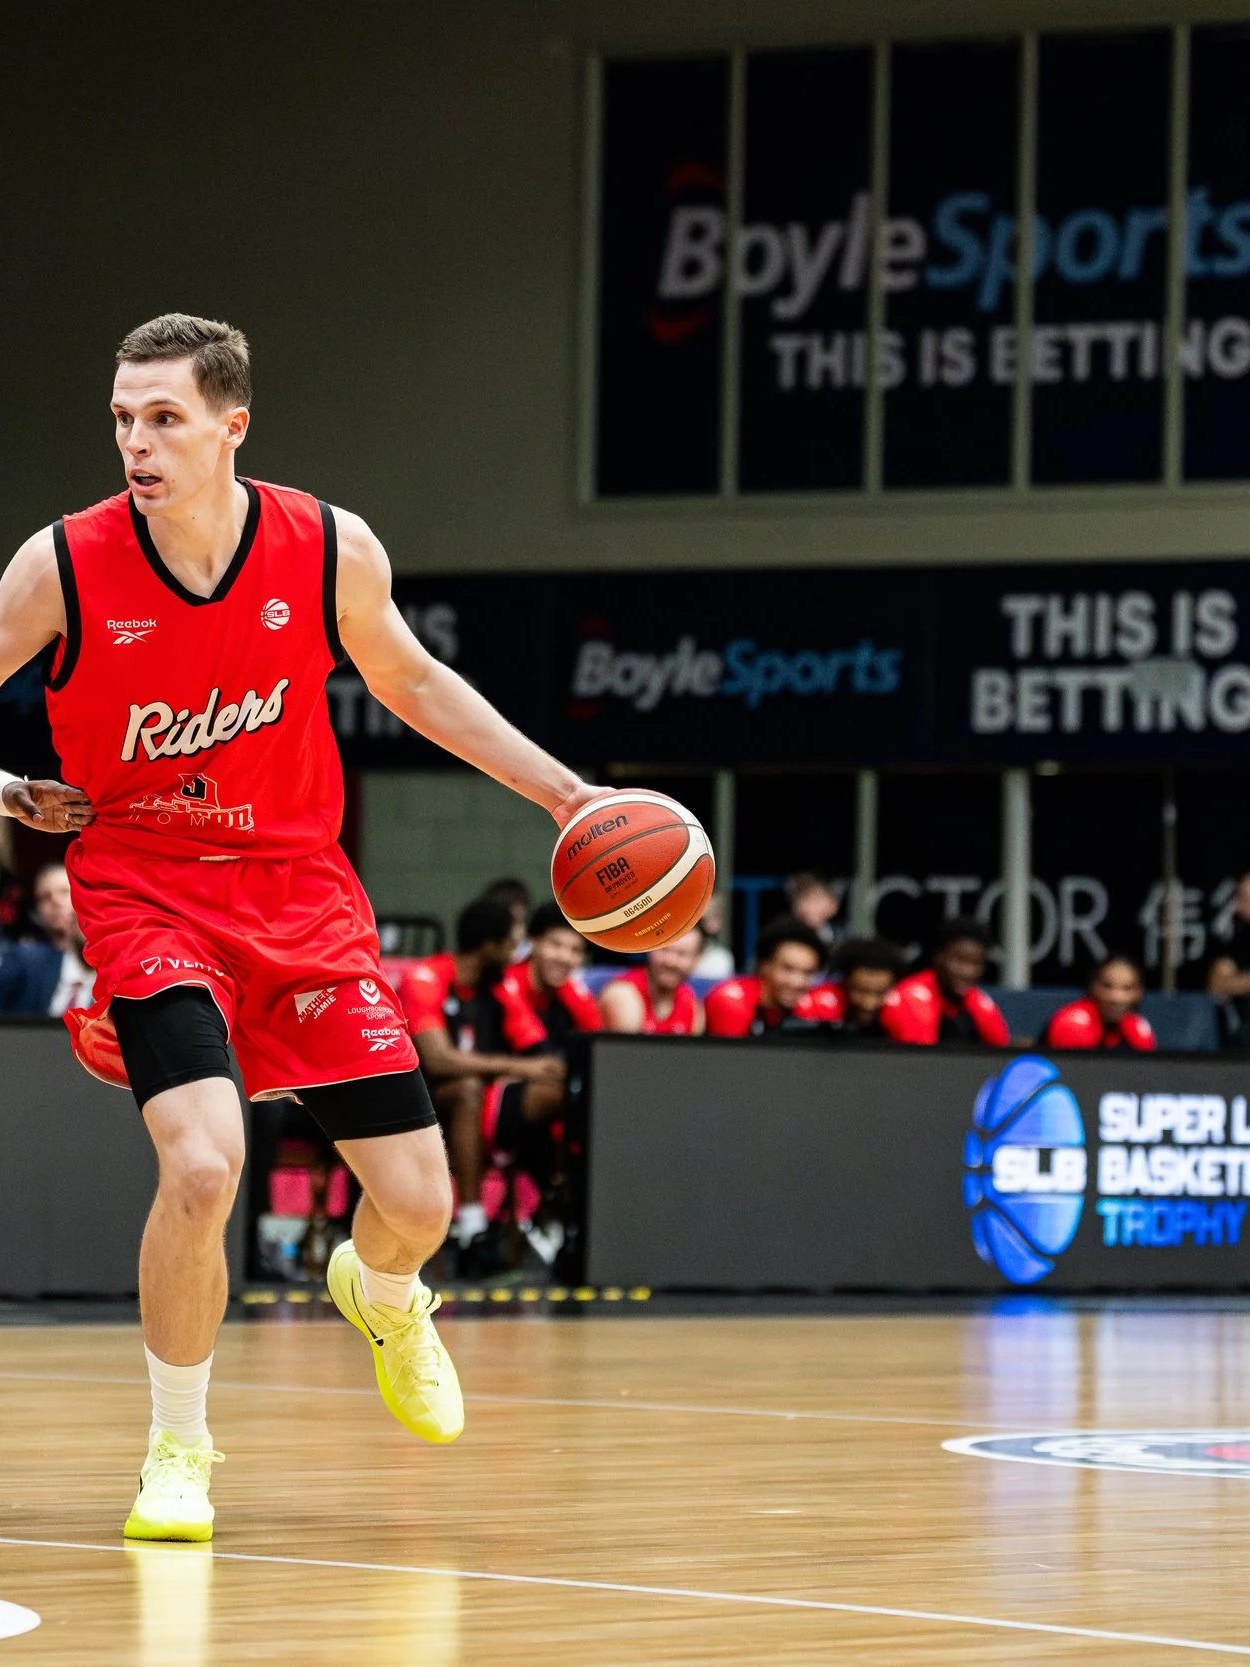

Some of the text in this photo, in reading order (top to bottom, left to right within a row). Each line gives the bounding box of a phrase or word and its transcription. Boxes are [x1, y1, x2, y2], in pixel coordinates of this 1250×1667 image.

[769, 330, 907, 390] THIS
[918, 330, 975, 385] IS
[107, 618, 157, 630] Reebok
[267, 609, 290, 618] SLB
[1000, 590, 1238, 659] THIS IS
[571, 635, 903, 712] BoyleSports
[119, 678, 289, 763] Riders
[566, 815, 629, 861] molten
[596, 856, 631, 887] FIBA
[623, 895, 653, 918] BG4500
[298, 988, 331, 1022] MATHER
[313, 994, 337, 1019] JAMIE
[362, 1027, 401, 1038] Reebok
[1099, 1092, 1227, 1144] SUPER
[992, 1144, 1088, 1194] SLB
[1096, 1199, 1248, 1248] TROPHY
